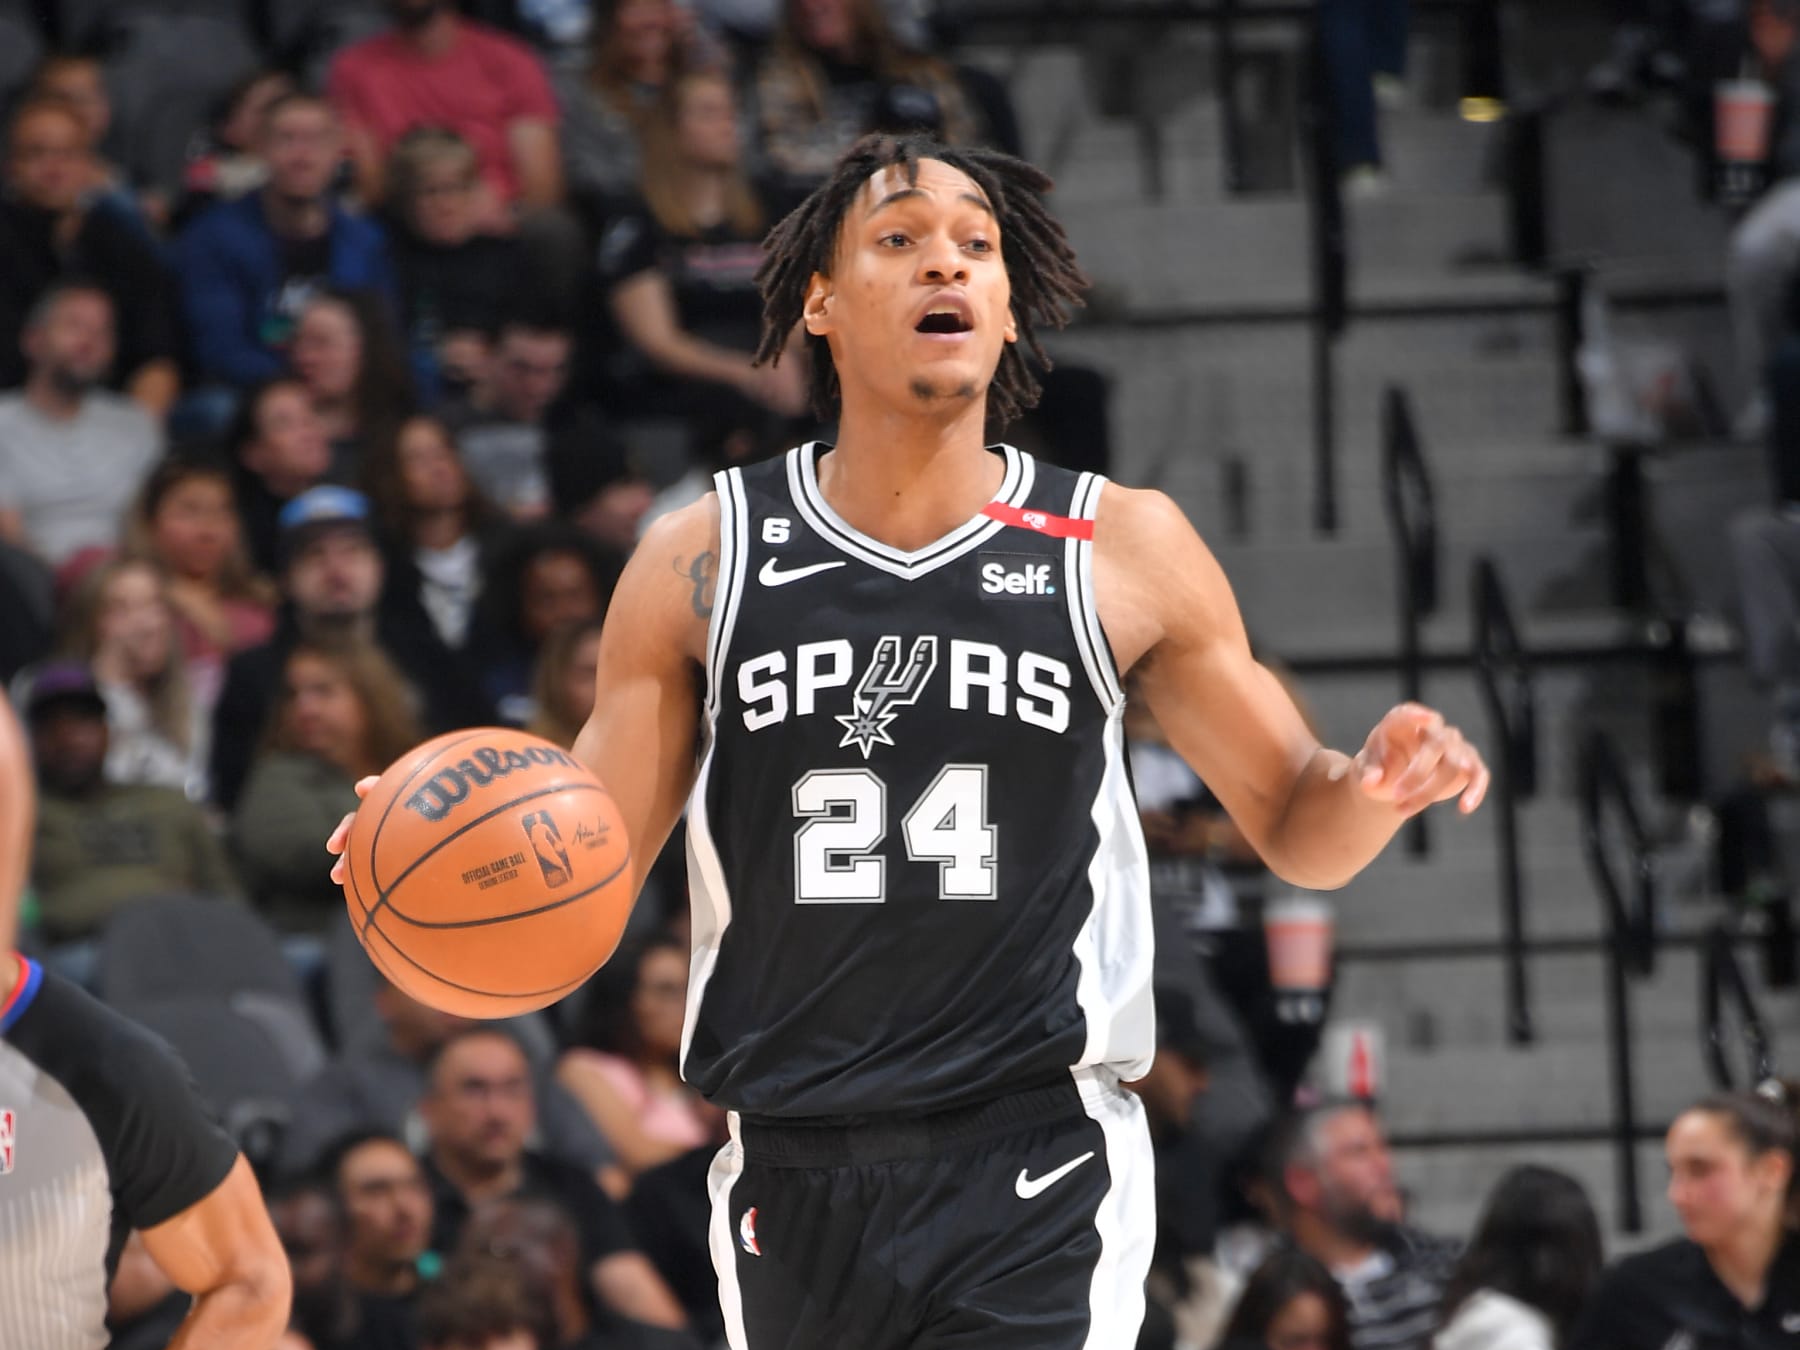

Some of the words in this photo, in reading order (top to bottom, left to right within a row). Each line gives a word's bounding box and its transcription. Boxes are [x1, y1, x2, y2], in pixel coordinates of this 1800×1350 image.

[761, 517, 791, 544] 6
[981, 562, 1056, 595] Self.
[737, 635, 1072, 760] SPURS
[405, 747, 584, 822] Wilson
[791, 764, 998, 904] 24
